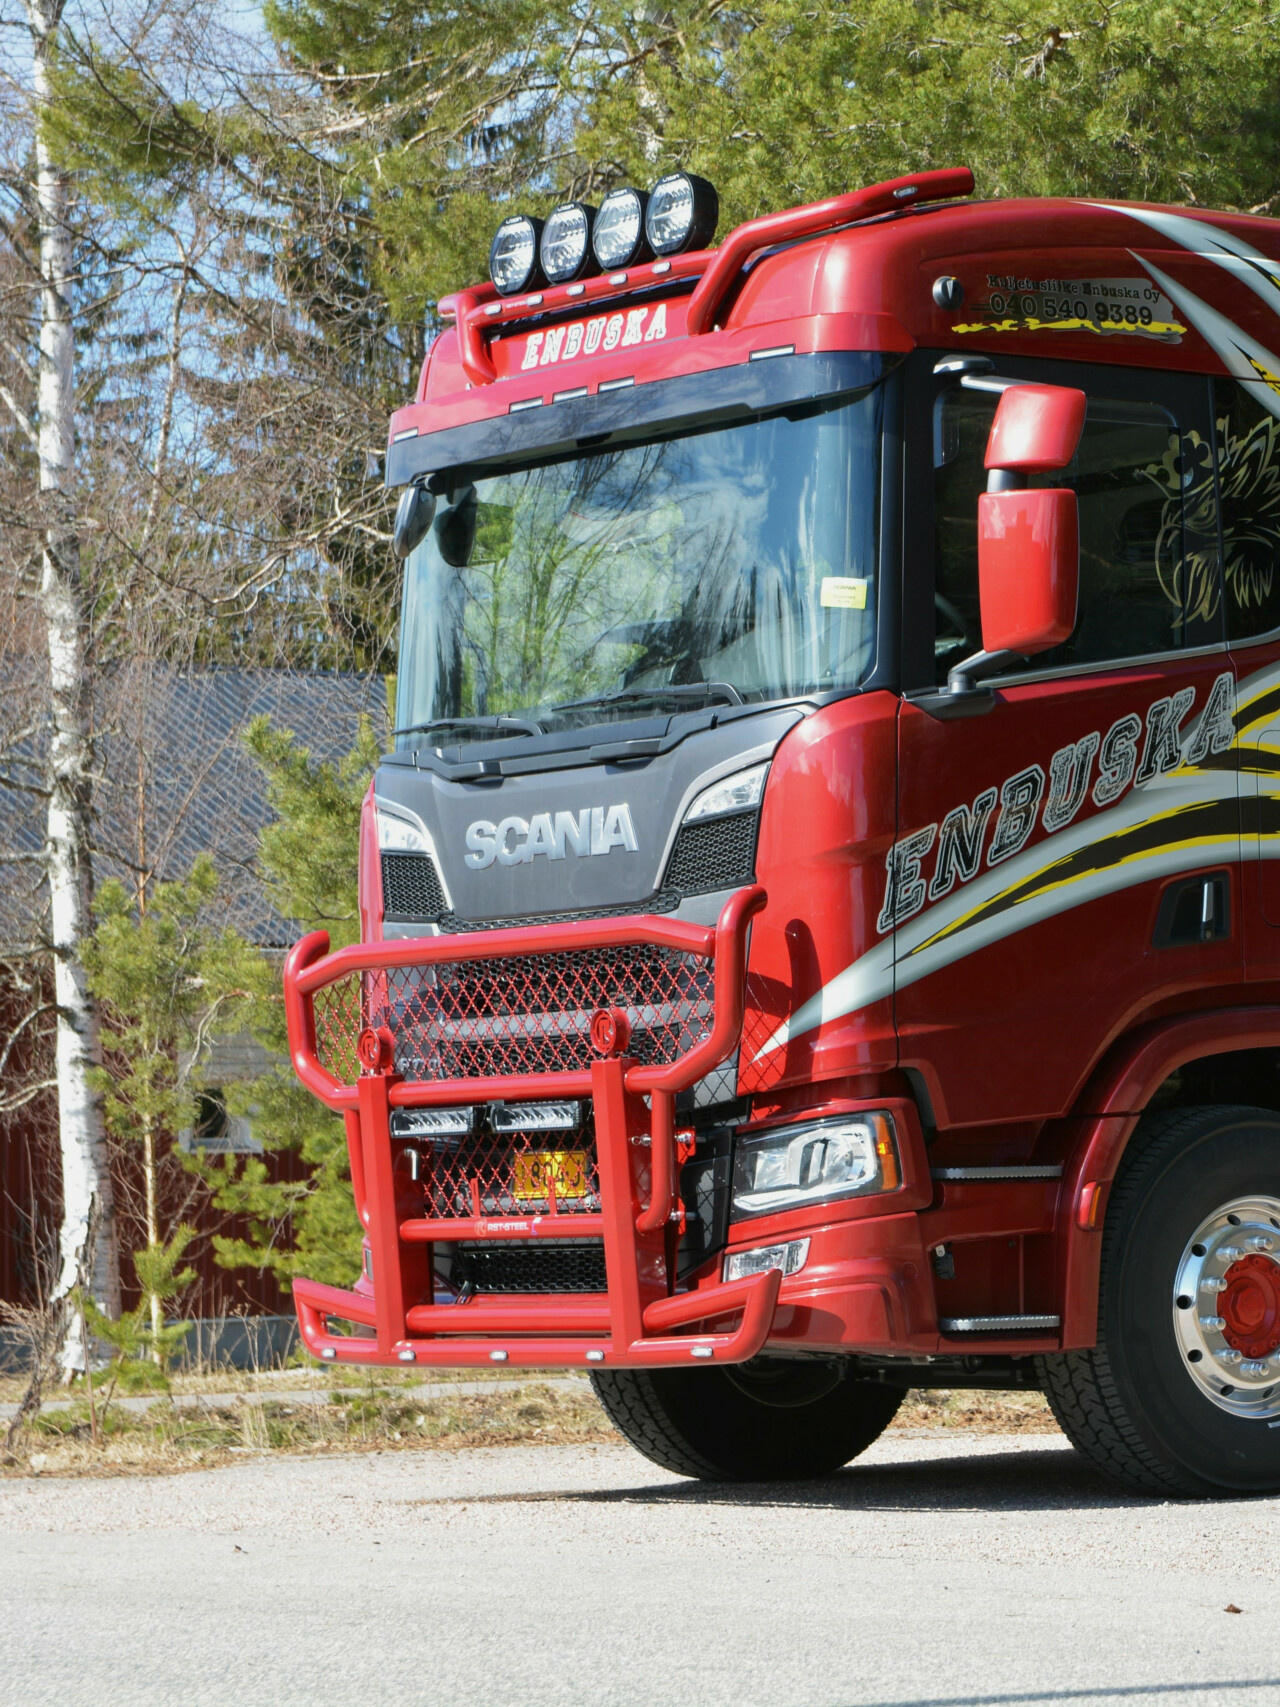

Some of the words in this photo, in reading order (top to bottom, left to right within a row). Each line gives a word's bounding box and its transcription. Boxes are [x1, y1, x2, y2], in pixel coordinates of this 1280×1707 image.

[990, 292, 1038, 317] 040
[1044, 297, 1088, 320] 540
[1095, 301, 1153, 326] 9389
[1082, 282, 1140, 299] Enbuska
[1143, 288, 1160, 304] Oy
[521, 303, 667, 370] ENBUSKA
[876, 672, 1236, 934] ENBUSKA
[464, 802, 640, 870] SCANIA
[487, 1221, 530, 1232] RST-STEEL
